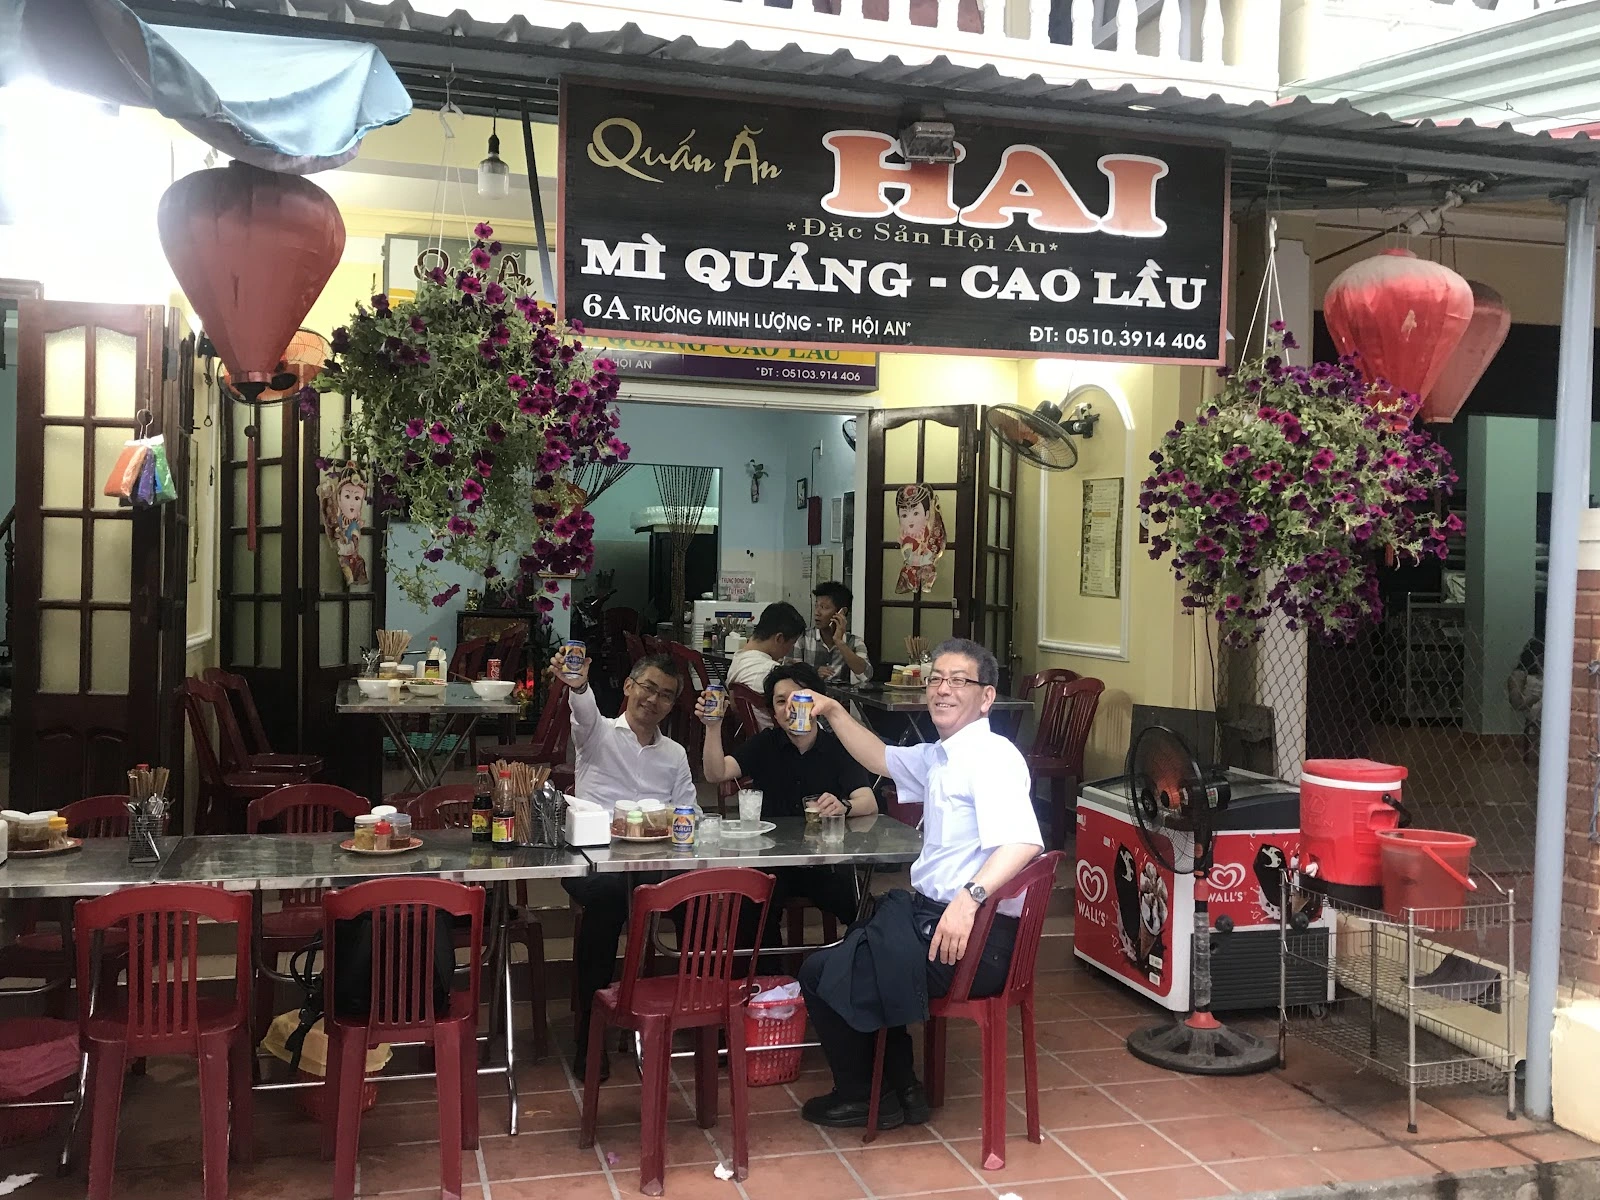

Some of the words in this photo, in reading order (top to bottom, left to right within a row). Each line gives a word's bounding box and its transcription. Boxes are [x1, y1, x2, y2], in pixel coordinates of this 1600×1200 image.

[586, 117, 716, 184] Quán
[723, 124, 783, 185] Ăn
[820, 129, 1170, 238] HAI
[874, 222, 931, 246] Sản
[940, 228, 997, 253] Hội
[580, 232, 667, 281] MÌ
[684, 241, 914, 299] QUẢNG
[960, 264, 1081, 303] CAO
[1092, 258, 1208, 311] LẦU
[582, 293, 631, 321] 6A
[633, 304, 703, 325] TRƯƠNG
[707, 310, 750, 328] MINH
[754, 312, 812, 334] LƯỢNG
[827, 317, 845, 334] TP.
[852, 316, 879, 338] HỘI
[1029, 326, 1060, 343] ĐT:
[1065, 327, 1167, 348] 0510.3914
[1171, 332, 1207, 351] 406
[635, 359, 652, 370] AN
[781, 368, 839, 380] 05103.914
[840, 371, 861, 382] 406
[1077, 899, 1107, 928] WALL'S
